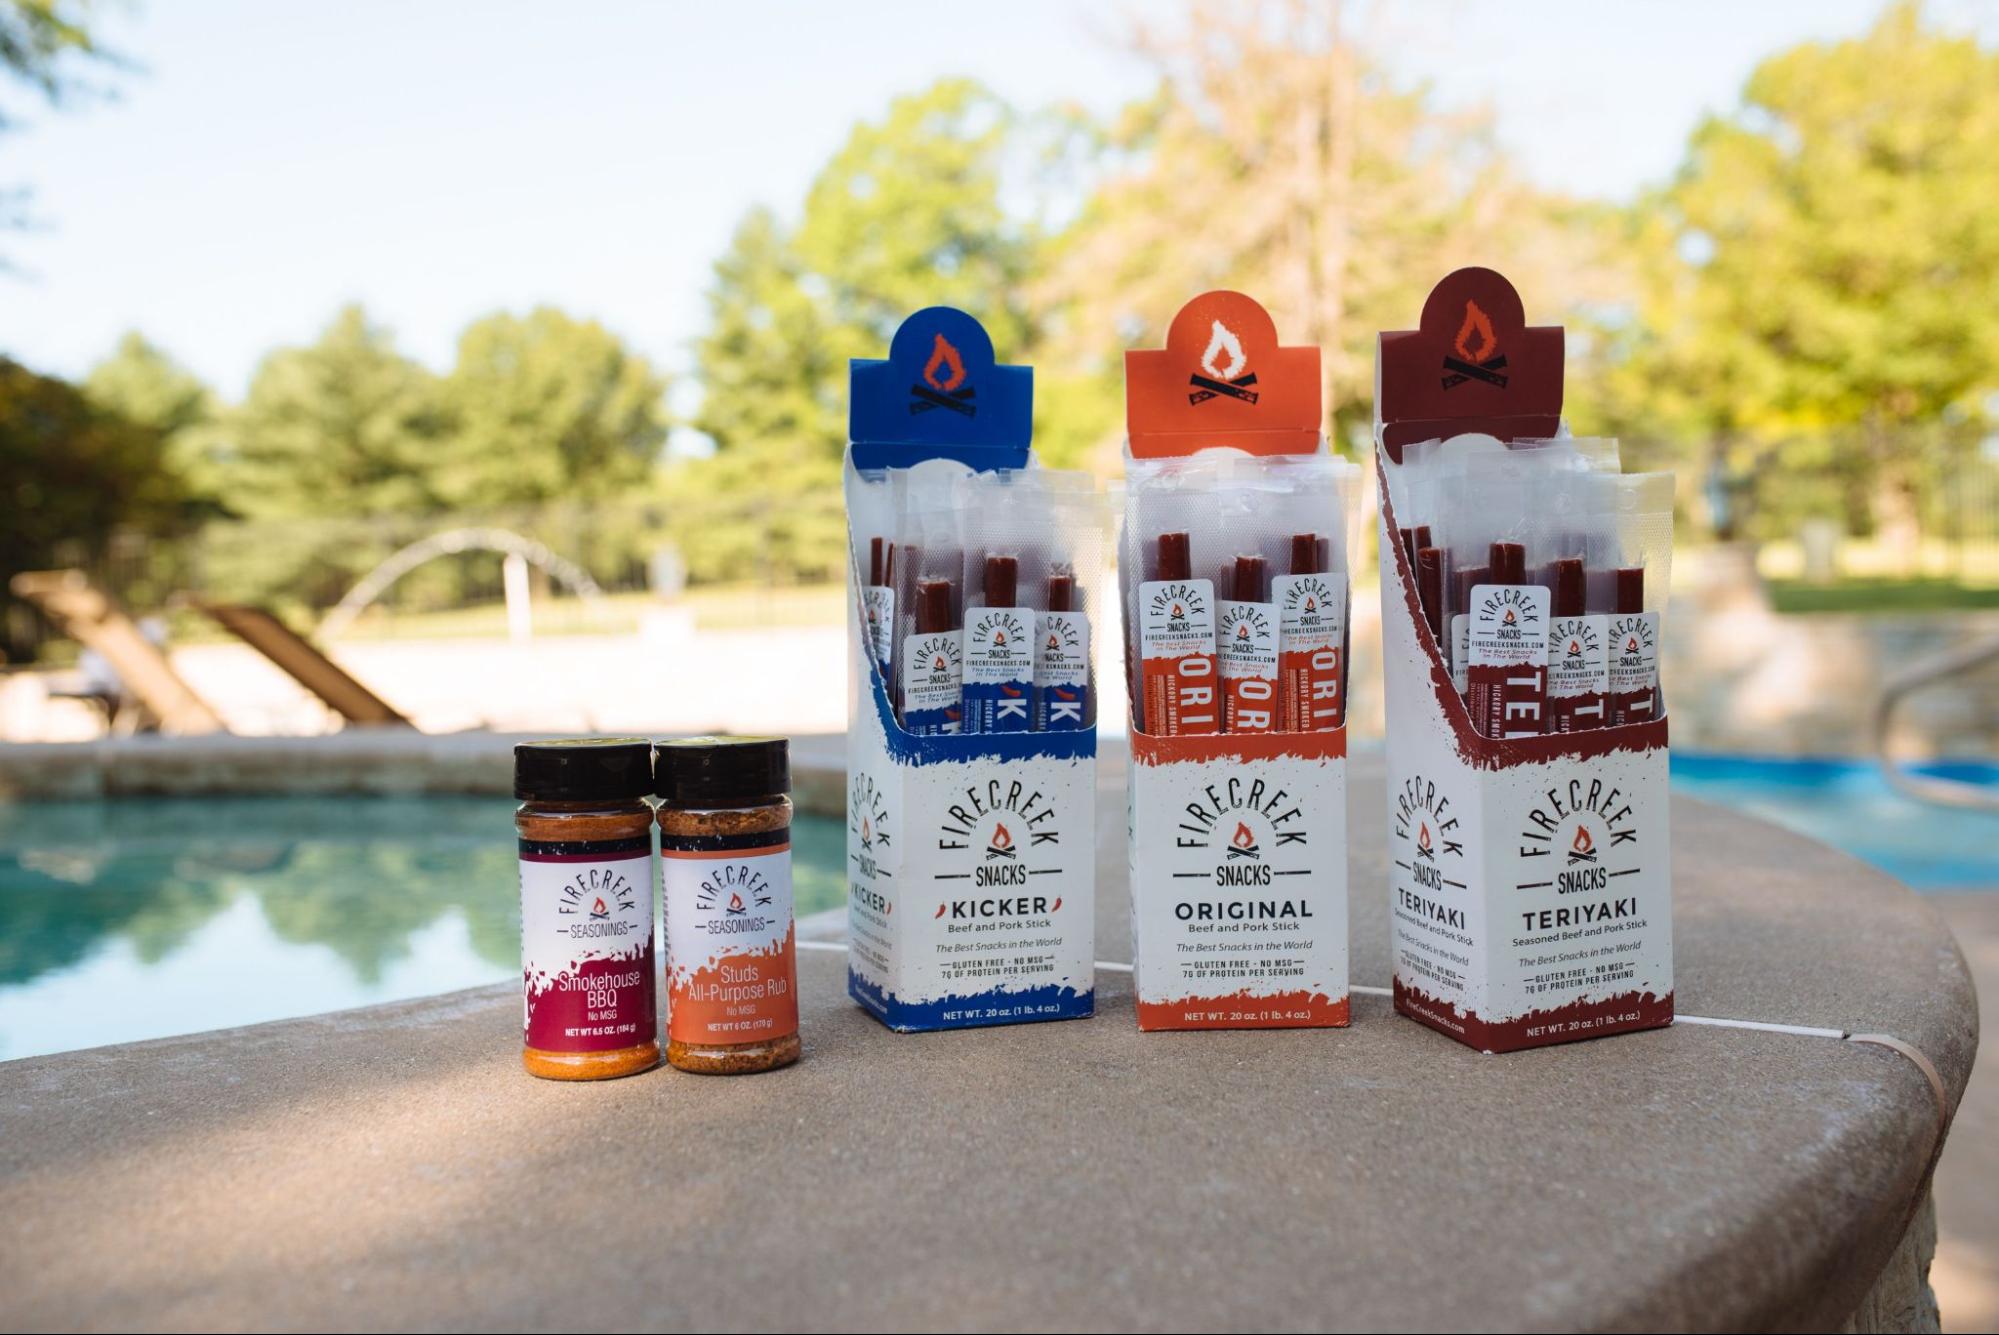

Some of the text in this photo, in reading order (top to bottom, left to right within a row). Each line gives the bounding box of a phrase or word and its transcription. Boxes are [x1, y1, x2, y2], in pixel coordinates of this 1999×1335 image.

[1151, 585, 1205, 616] FIRECREEK
[1284, 578, 1333, 609] FIRECREEK
[1480, 589, 1538, 622] FIRECREEK
[973, 613, 1025, 642] FIRECREEK
[1167, 622, 1190, 632] SNACKS
[1220, 606, 1270, 638] FIRECREEK
[1300, 616, 1320, 626] SNACKS
[1497, 629, 1521, 639] SNACKS
[914, 638, 962, 670] FIRECREEK
[989, 650, 1010, 658] SNACKS
[1232, 644, 1253, 653] SNACKS
[1563, 660, 1585, 670] SNACKS
[1620, 657, 1642, 666] SNACKS
[929, 674, 951, 684] SNACKS
[1312, 652, 1337, 732] ORI
[940, 780, 1058, 849] FIRECREEK
[1177, 777, 1307, 848] FIRECREEK
[1396, 775, 1463, 858] FIRECREEK
[1520, 779, 1637, 857] FIRECREEK
[976, 864, 1026, 887] SNACKS
[1217, 865, 1270, 886] SNACKS
[1413, 861, 1442, 891] SNACKS
[1558, 867, 1606, 894] SNACKS
[559, 869, 635, 913] FIRECREEK
[697, 866, 771, 910] FIRECREEK
[952, 897, 1046, 919] KICKER
[1175, 900, 1313, 920] ORIGINAL
[1399, 888, 1464, 930] TERIYAKI
[1523, 898, 1636, 931] TERIYAKI
[571, 921, 628, 938] SEASONINGS
[708, 917, 765, 934] SEASONINGS
[948, 919, 1051, 933] Beef and Pork Stick
[1189, 922, 1300, 932] Beef and Pork Stick
[1429, 925, 1440, 934] and
[1442, 928, 1455, 940] Pork
[1456, 934, 1473, 946] Stick
[1513, 920, 1647, 947] Seasoned Beef and Pork Stick
[954, 944, 973, 952] Best
[976, 942, 1006, 950] Snacks
[1020, 940, 1033, 948] the
[1036, 938, 1062, 946] World
[1176, 940, 1313, 952] The Best Snacks in the World
[1520, 941, 1641, 967] The Best Snacks in the World
[952, 961, 982, 969] GLUTEN
[1028, 956, 1043, 964] MSG
[1229, 960, 1249, 968] FREE
[1450, 952, 1468, 966] World
[559, 971, 640, 991] Smokehouse
[721, 964, 759, 983] Studs
[942, 965, 1054, 979] 7G OF PROTEIN PER SERVING
[1269, 968, 1304, 976] SERVING
[1525, 970, 1634, 994] 7G OF PROTEIN PER SERVING
[1536, 962, 1623, 983] GLUTEN FREE NO MSG
[588, 989, 617, 1008] BBQ
[689, 977, 786, 1004] All-Purpose Rub
[588, 1010, 617, 1021] No MSG
[727, 1005, 756, 1016] No MSG
[944, 1011, 962, 1020] NET
[965, 1010, 982, 1018] WT.
[986, 1009, 997, 1017] 20
[1013, 1007, 1021, 1015] (1
[1024, 1006, 1035, 1014] lb.
[1044, 1004, 1060, 1012] oz.)
[1185, 1012, 1204, 1020] NET
[1208, 1012, 1226, 1020] WT.
[1230, 1012, 1242, 1020] 20
[1260, 1011, 1268, 1020] (1
[1272, 1011, 1283, 1019] lb.
[1294, 1010, 1311, 1019] oz.)
[581, 1027, 591, 1036] WT
[604, 1026, 615, 1035] OZ.
[708, 1023, 721, 1031] NET
[735, 1022, 739, 1030] 6
[1527, 1026, 1545, 1037] NET
[1548, 1024, 1566, 1033] WT.
[1569, 1021, 1579, 1030] 20
[1581, 1020, 1594, 1028] oz.
[1596, 1017, 1604, 1027] (1
[1606, 1015, 1616, 1024] lb.
[1625, 1011, 1640, 1020] oz.)
